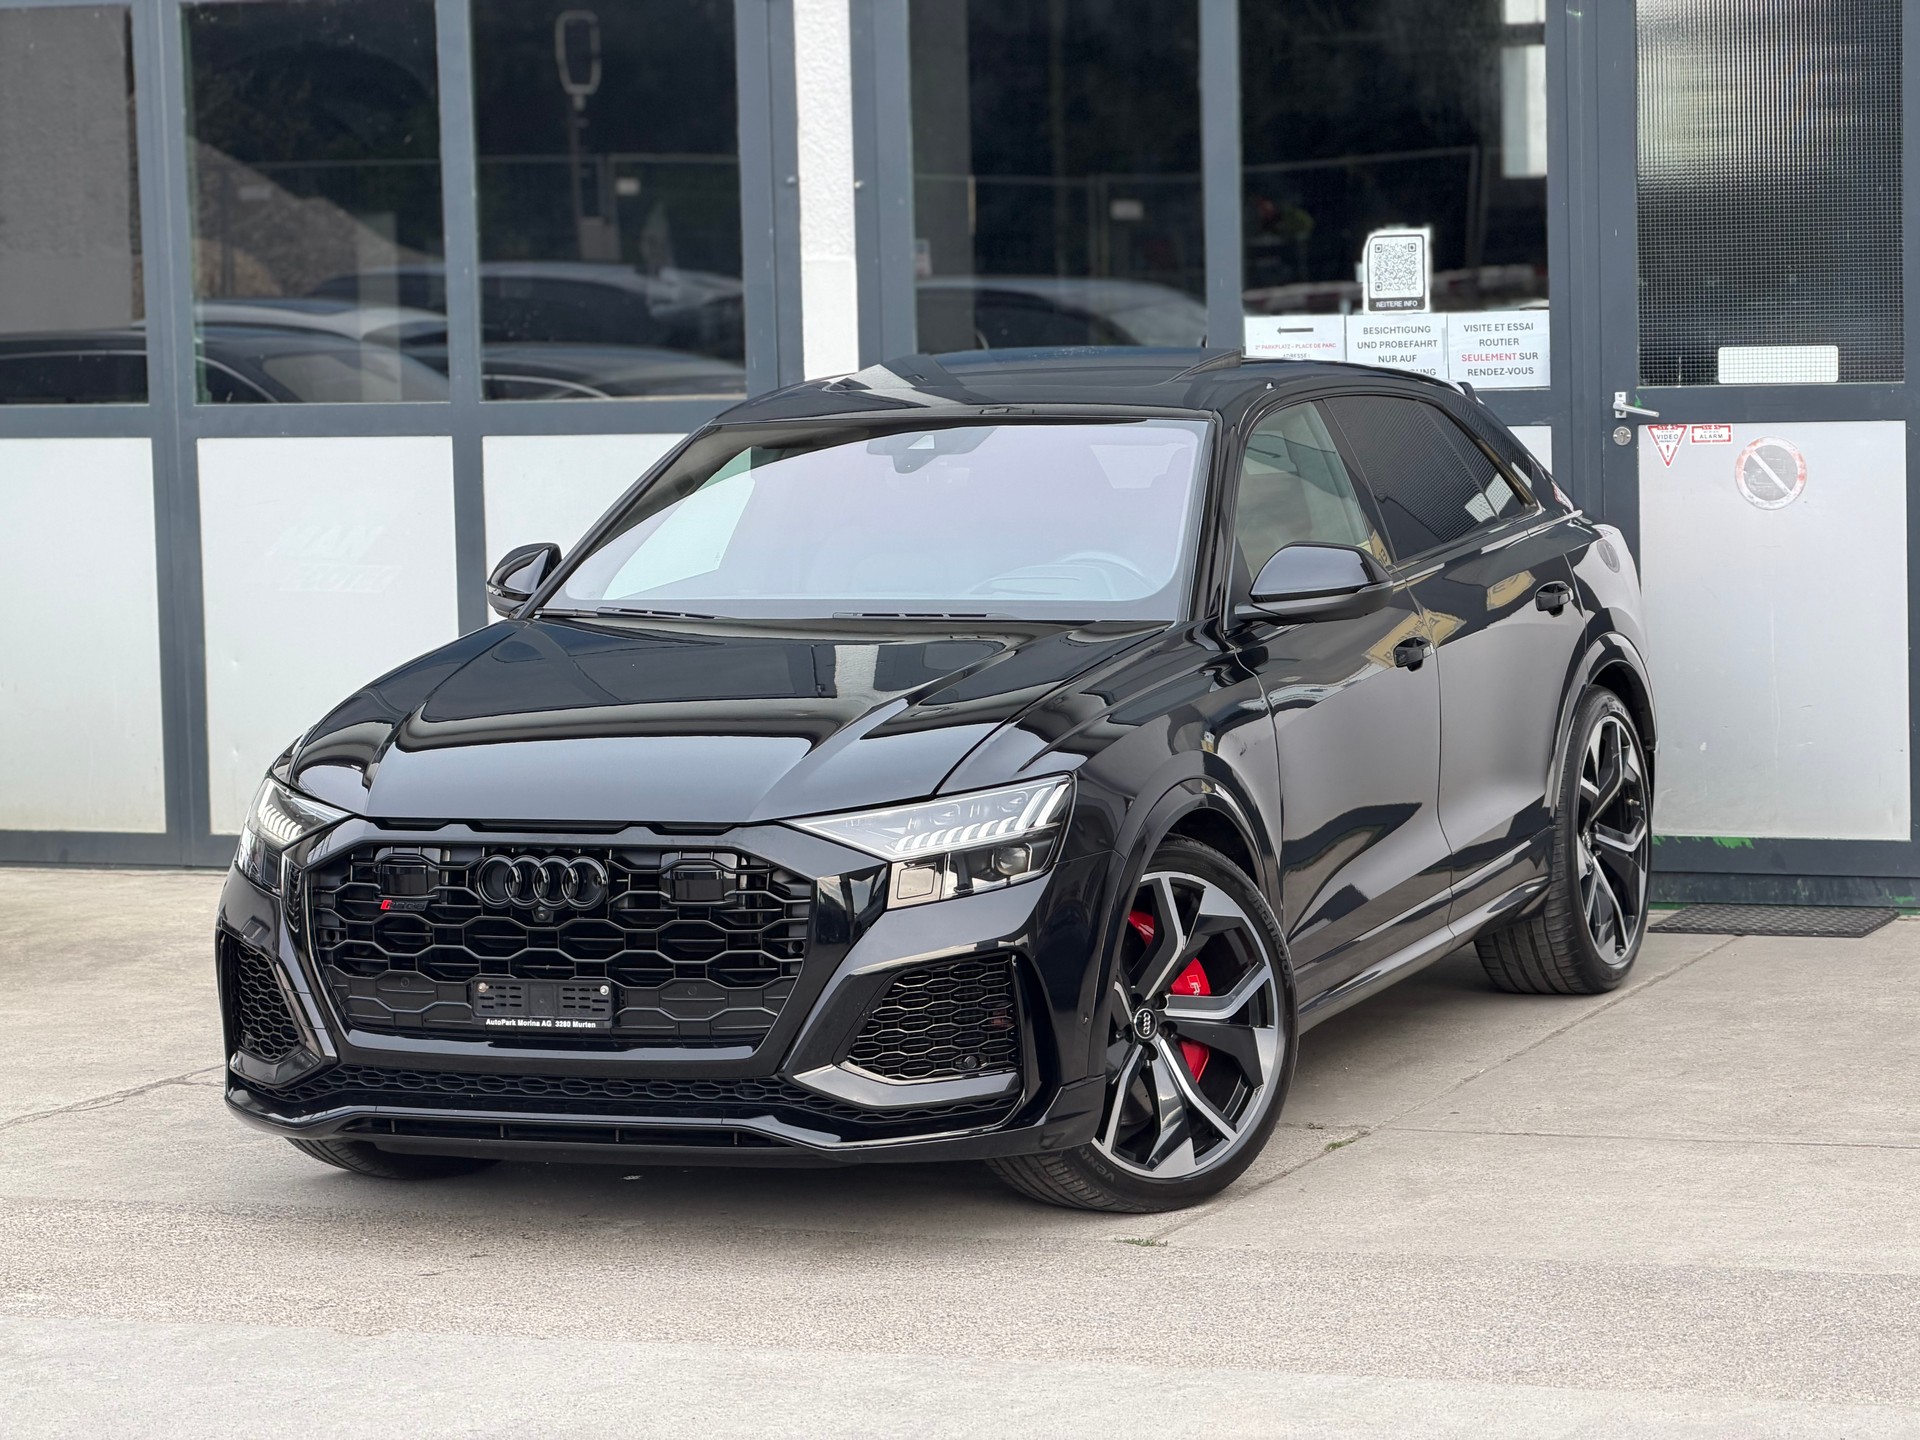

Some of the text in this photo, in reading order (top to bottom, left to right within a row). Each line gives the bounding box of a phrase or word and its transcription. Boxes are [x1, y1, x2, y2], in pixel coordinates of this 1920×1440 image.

[1363, 326, 1431, 334] BESICHTIGUNG
[1464, 324, 1492, 332] VISITE
[1508, 322, 1534, 330] ESSAI
[1380, 340, 1438, 348] PROBEFAHRT
[1480, 338, 1520, 346] ROUTIER
[1400, 354, 1417, 362] AUF
[1462, 353, 1516, 362] SEULEMENT
[1468, 367, 1534, 376] RENDEZ-VOUS
